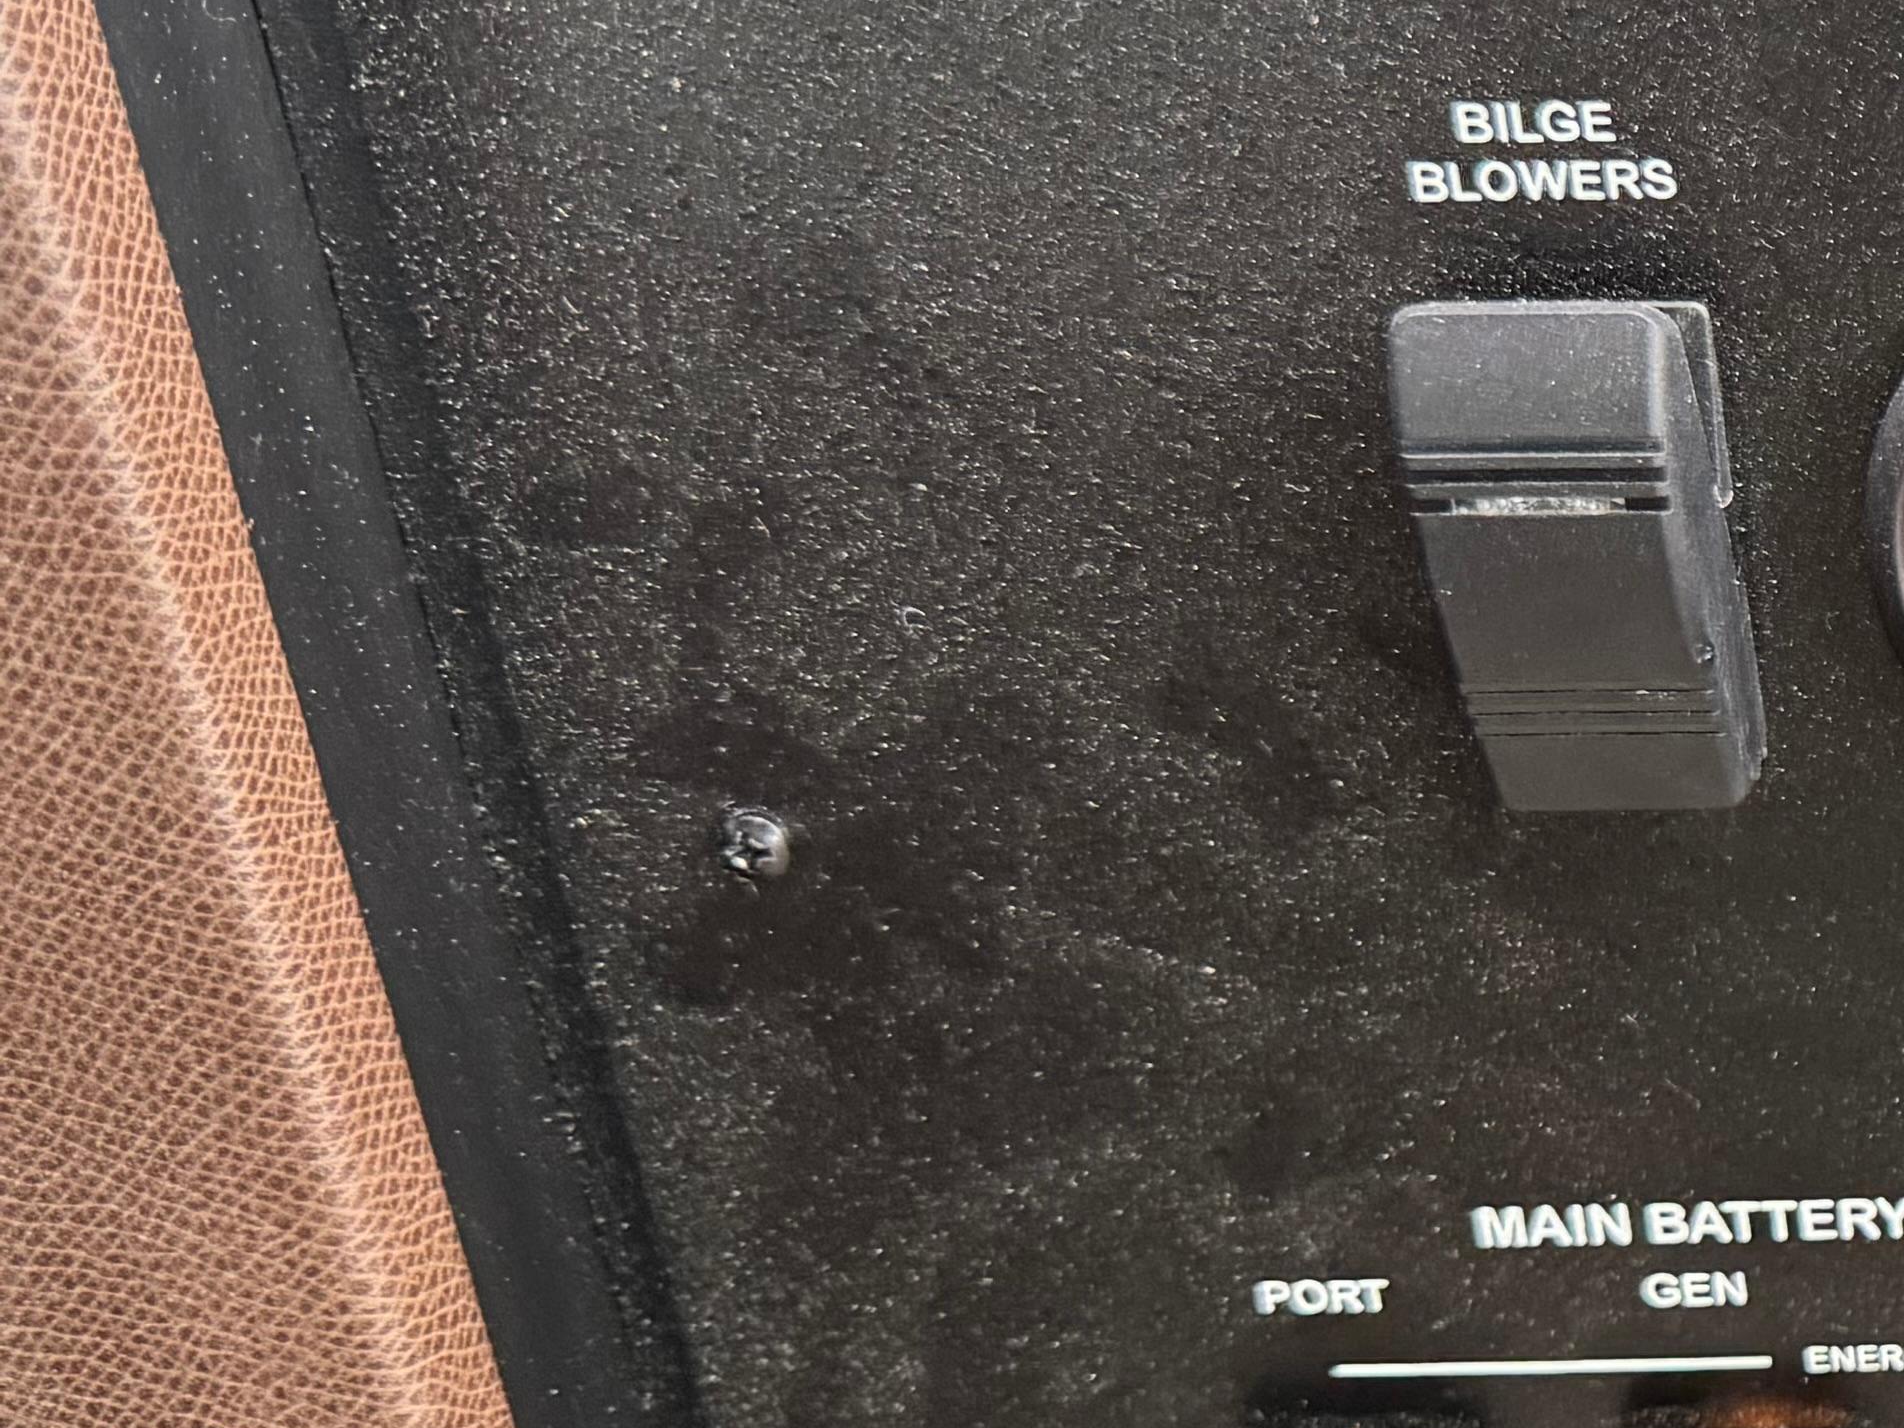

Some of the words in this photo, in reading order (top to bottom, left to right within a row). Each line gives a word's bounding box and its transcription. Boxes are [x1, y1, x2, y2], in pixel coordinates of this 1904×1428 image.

[1451, 99, 1617, 144] BILGE
[1406, 158, 1678, 203] BLOWERS
[1471, 1202, 1633, 1249] MAIN
[1253, 1278, 1389, 1315] PORT
[1640, 1271, 1748, 1308] GEN
